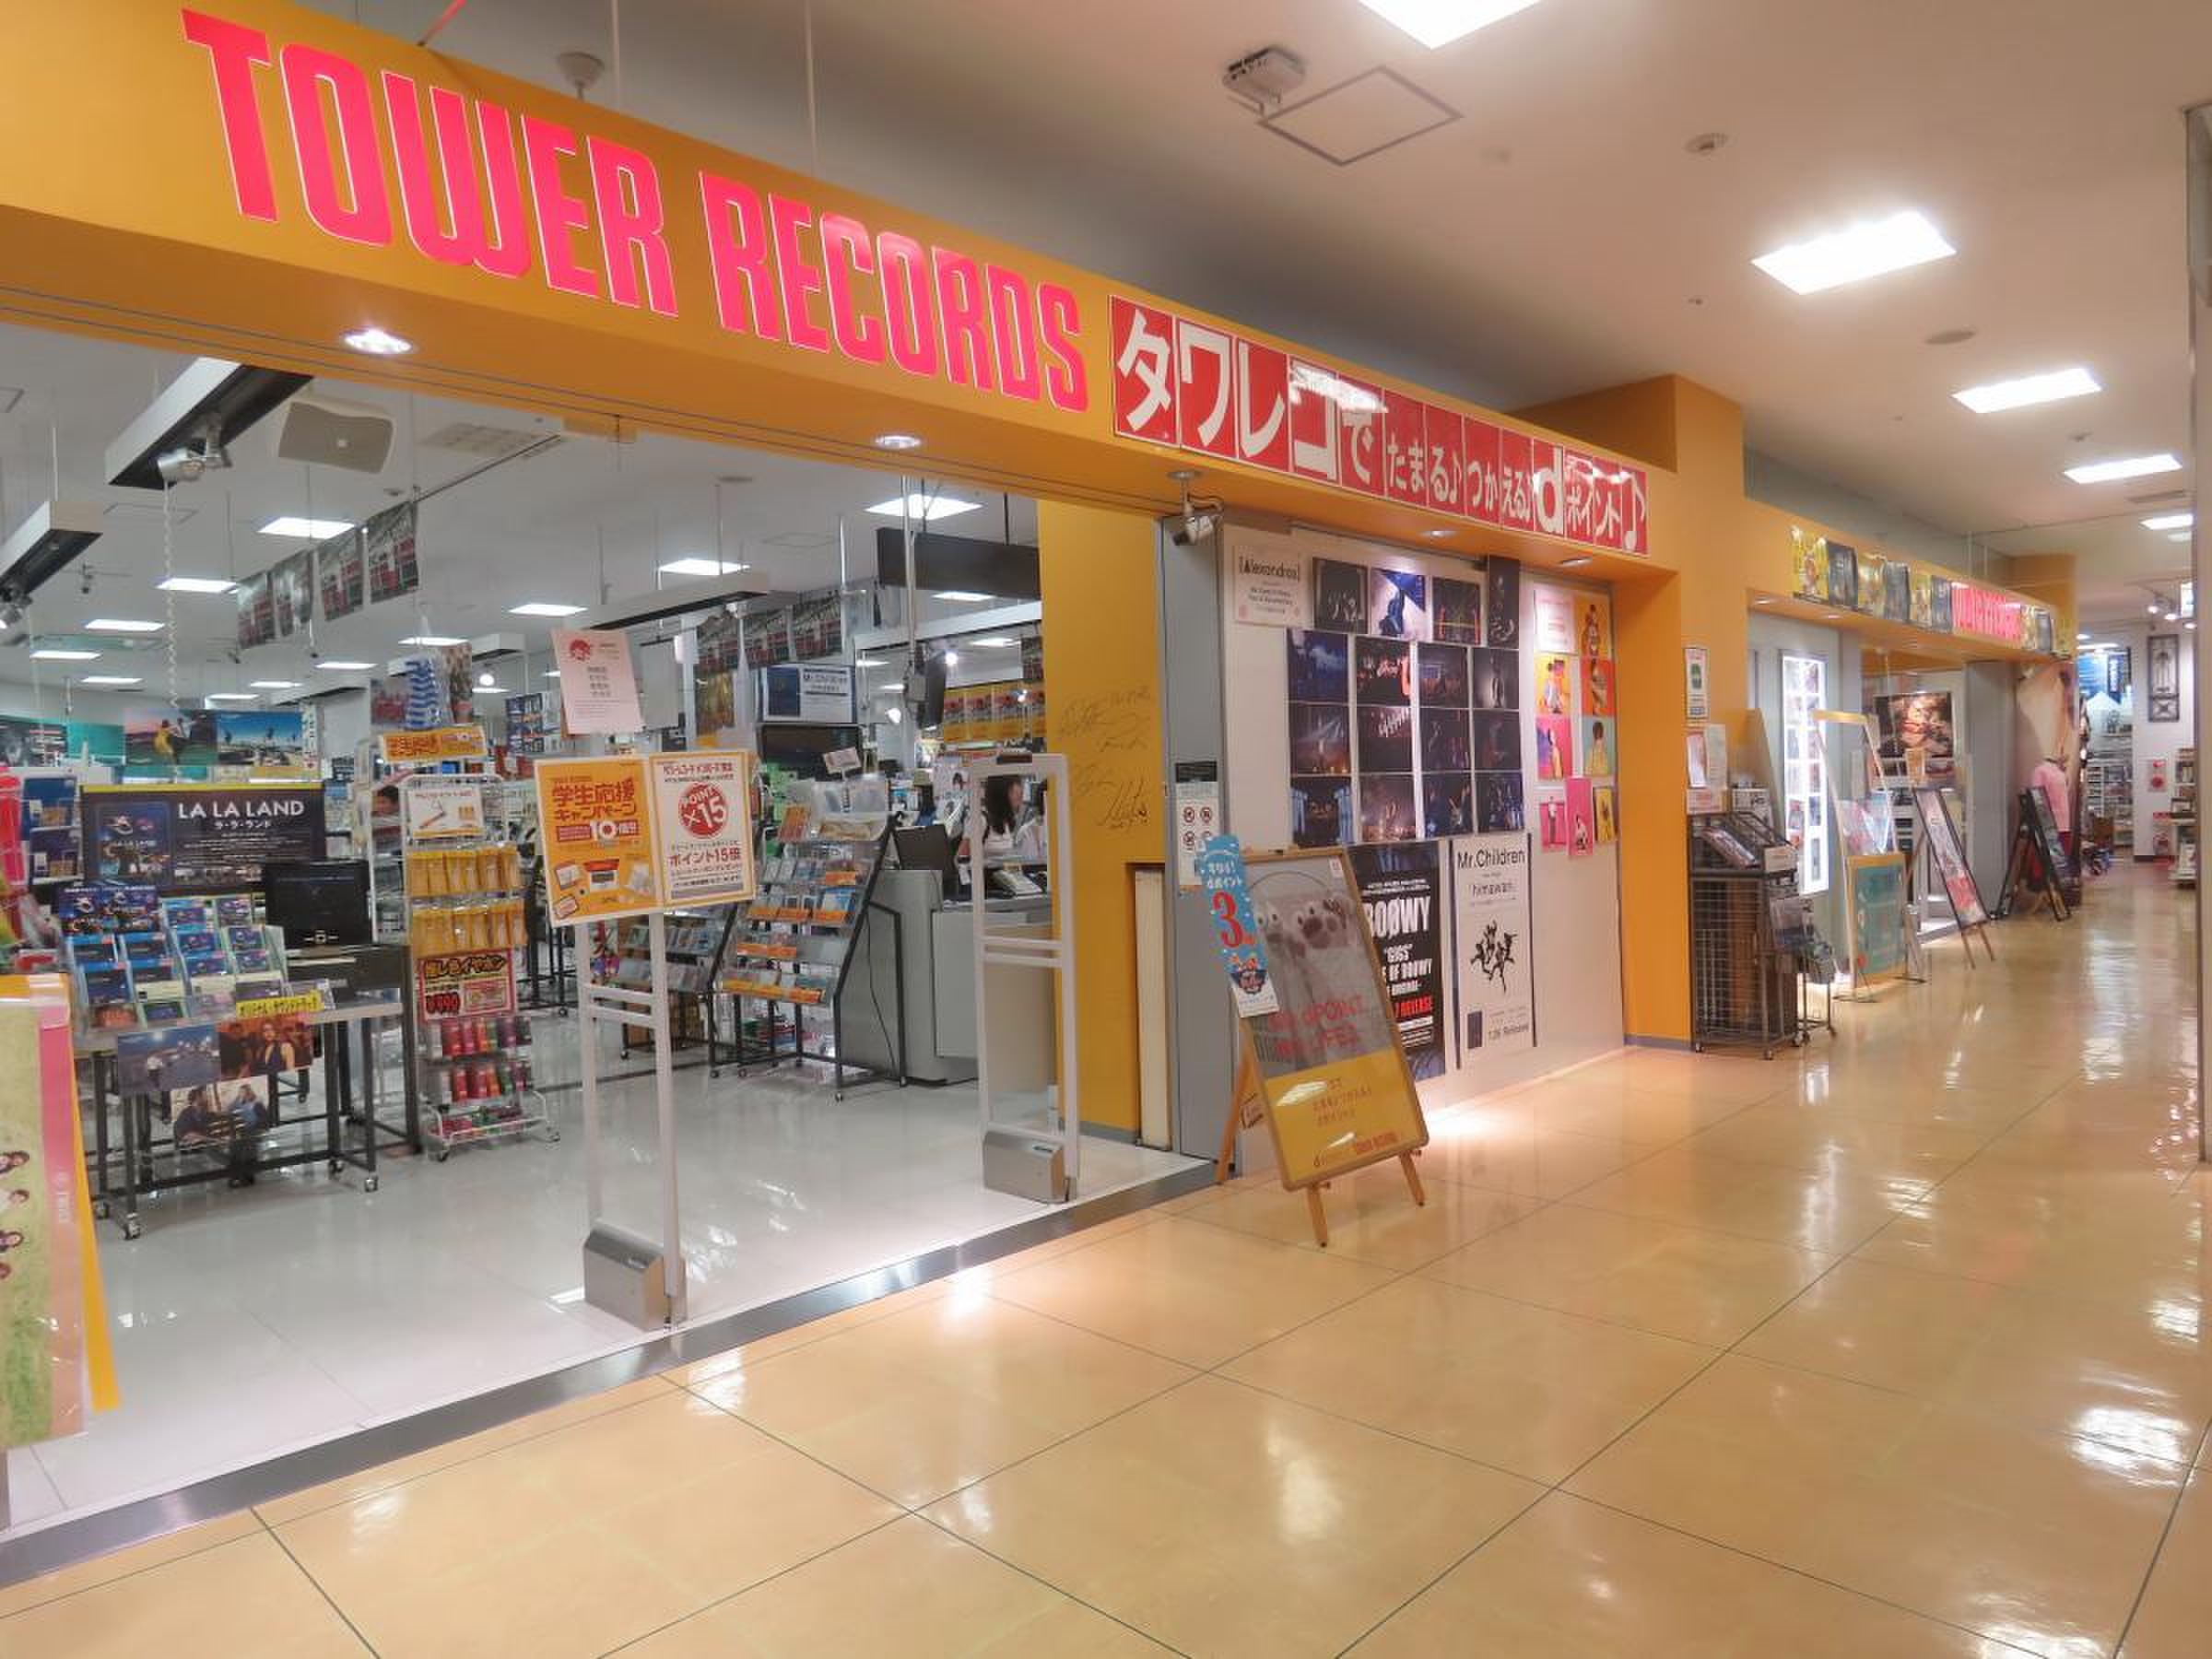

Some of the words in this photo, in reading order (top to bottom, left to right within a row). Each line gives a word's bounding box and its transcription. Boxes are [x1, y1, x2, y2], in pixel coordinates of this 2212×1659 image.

[182, 8, 678, 317] TOWER
[699, 171, 1089, 413] RECORDS
[178, 803, 206, 818] LA
[213, 801, 240, 818] LA
[246, 800, 305, 817] LAND
[1458, 849, 1525, 868] Mr.Children
[1211, 891, 1243, 948] 3
